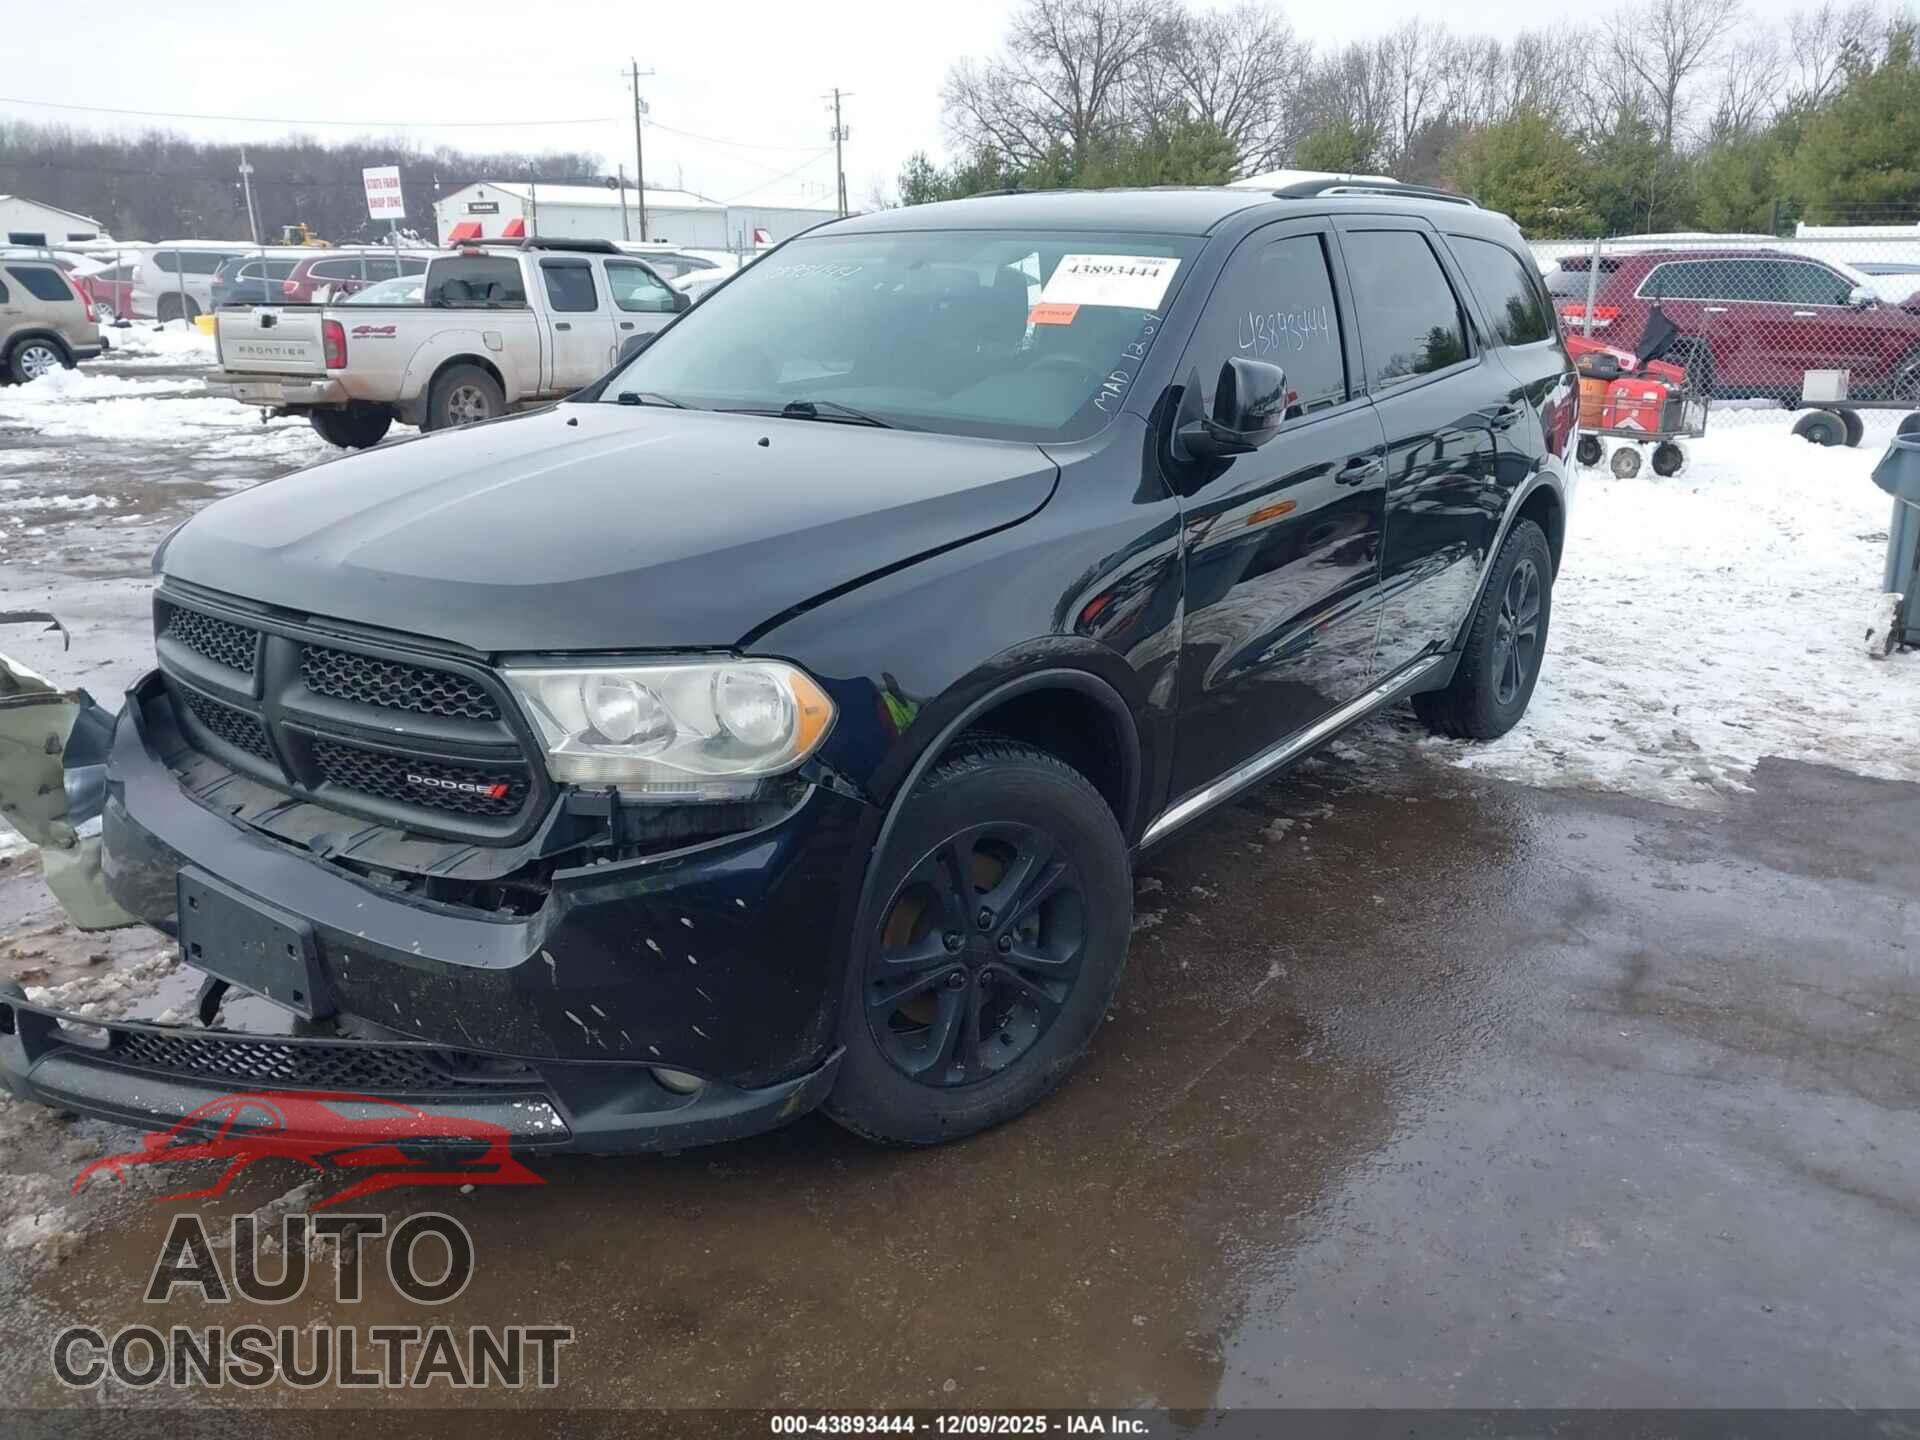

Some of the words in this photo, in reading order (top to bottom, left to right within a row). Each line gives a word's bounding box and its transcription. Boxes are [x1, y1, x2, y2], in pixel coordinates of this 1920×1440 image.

[1067, 264, 1160, 278] 43893444
[1239, 304, 1330, 357] 43893444
[238, 345, 306, 357] FRONTIER
[1094, 369, 1131, 412] MAD
[407, 775, 494, 795] DODGE
